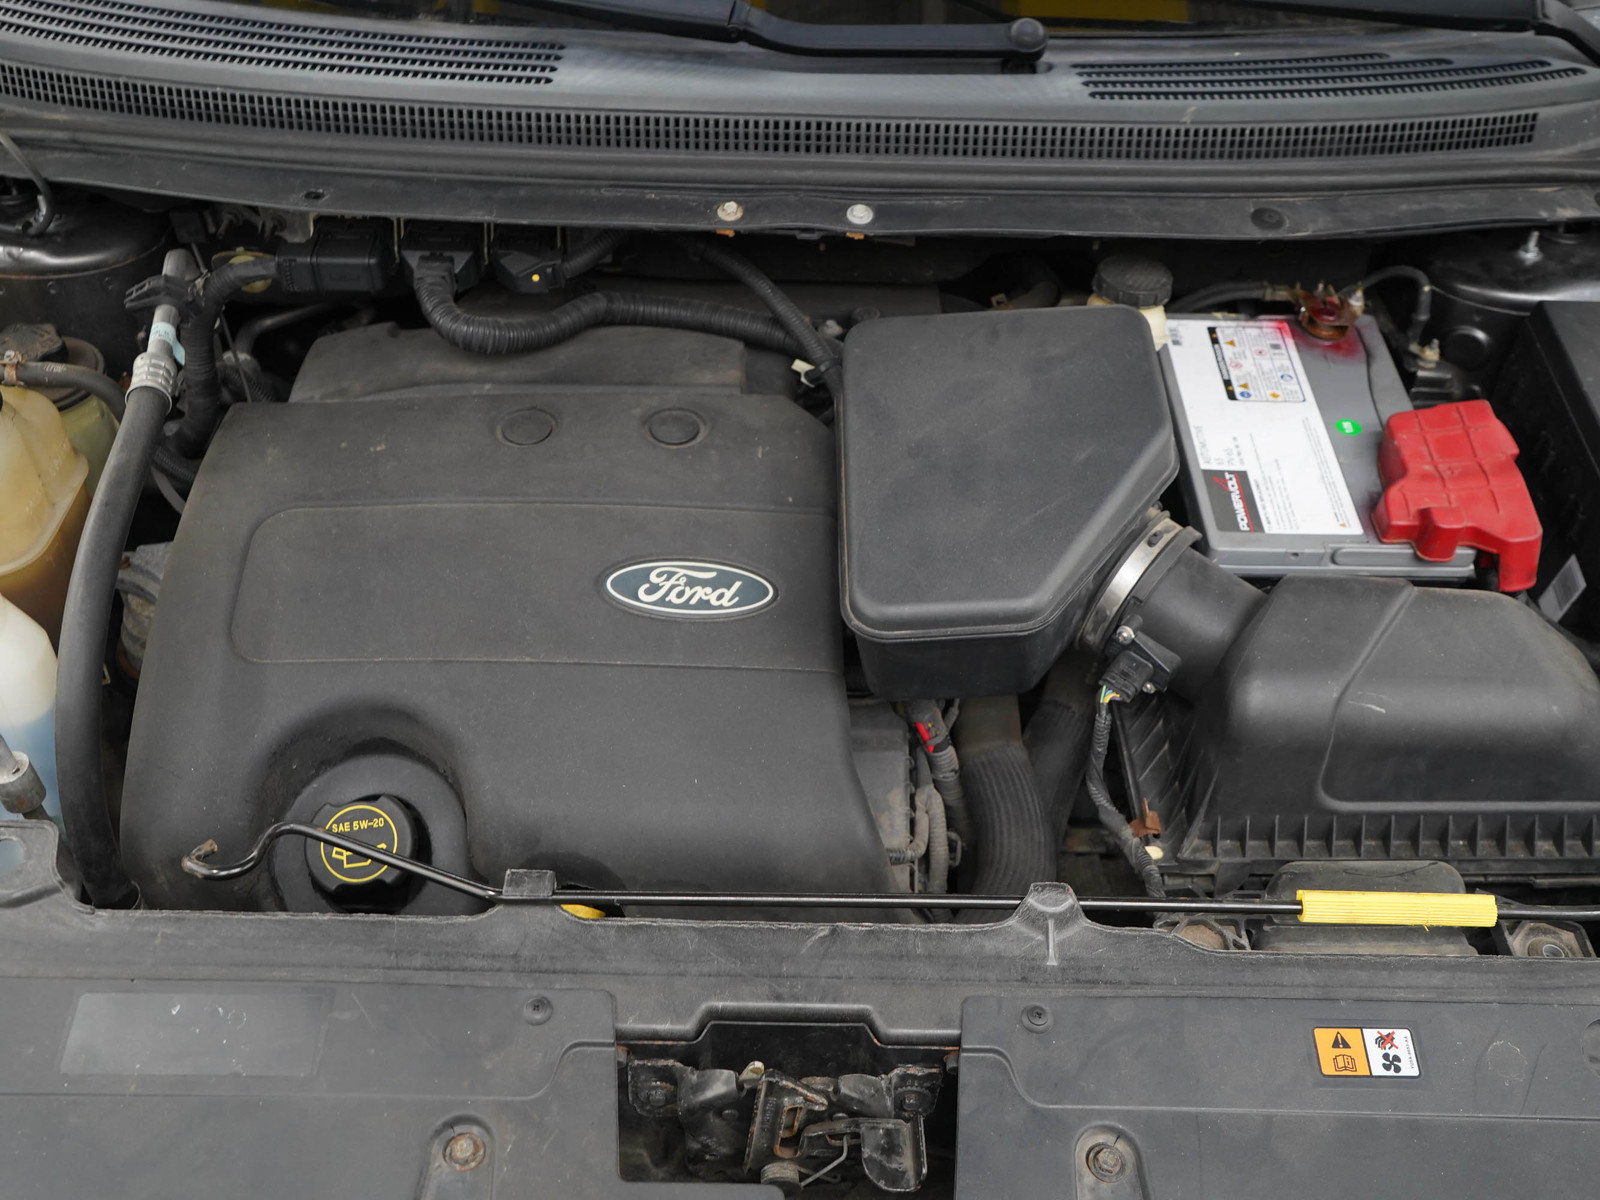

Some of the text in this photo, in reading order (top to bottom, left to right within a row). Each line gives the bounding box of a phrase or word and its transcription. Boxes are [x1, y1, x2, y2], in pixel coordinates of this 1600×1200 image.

[1225, 471, 1250, 531] POWERVOLT
[637, 566, 743, 607] Ford
[332, 817, 385, 833] SAE 5W-20
